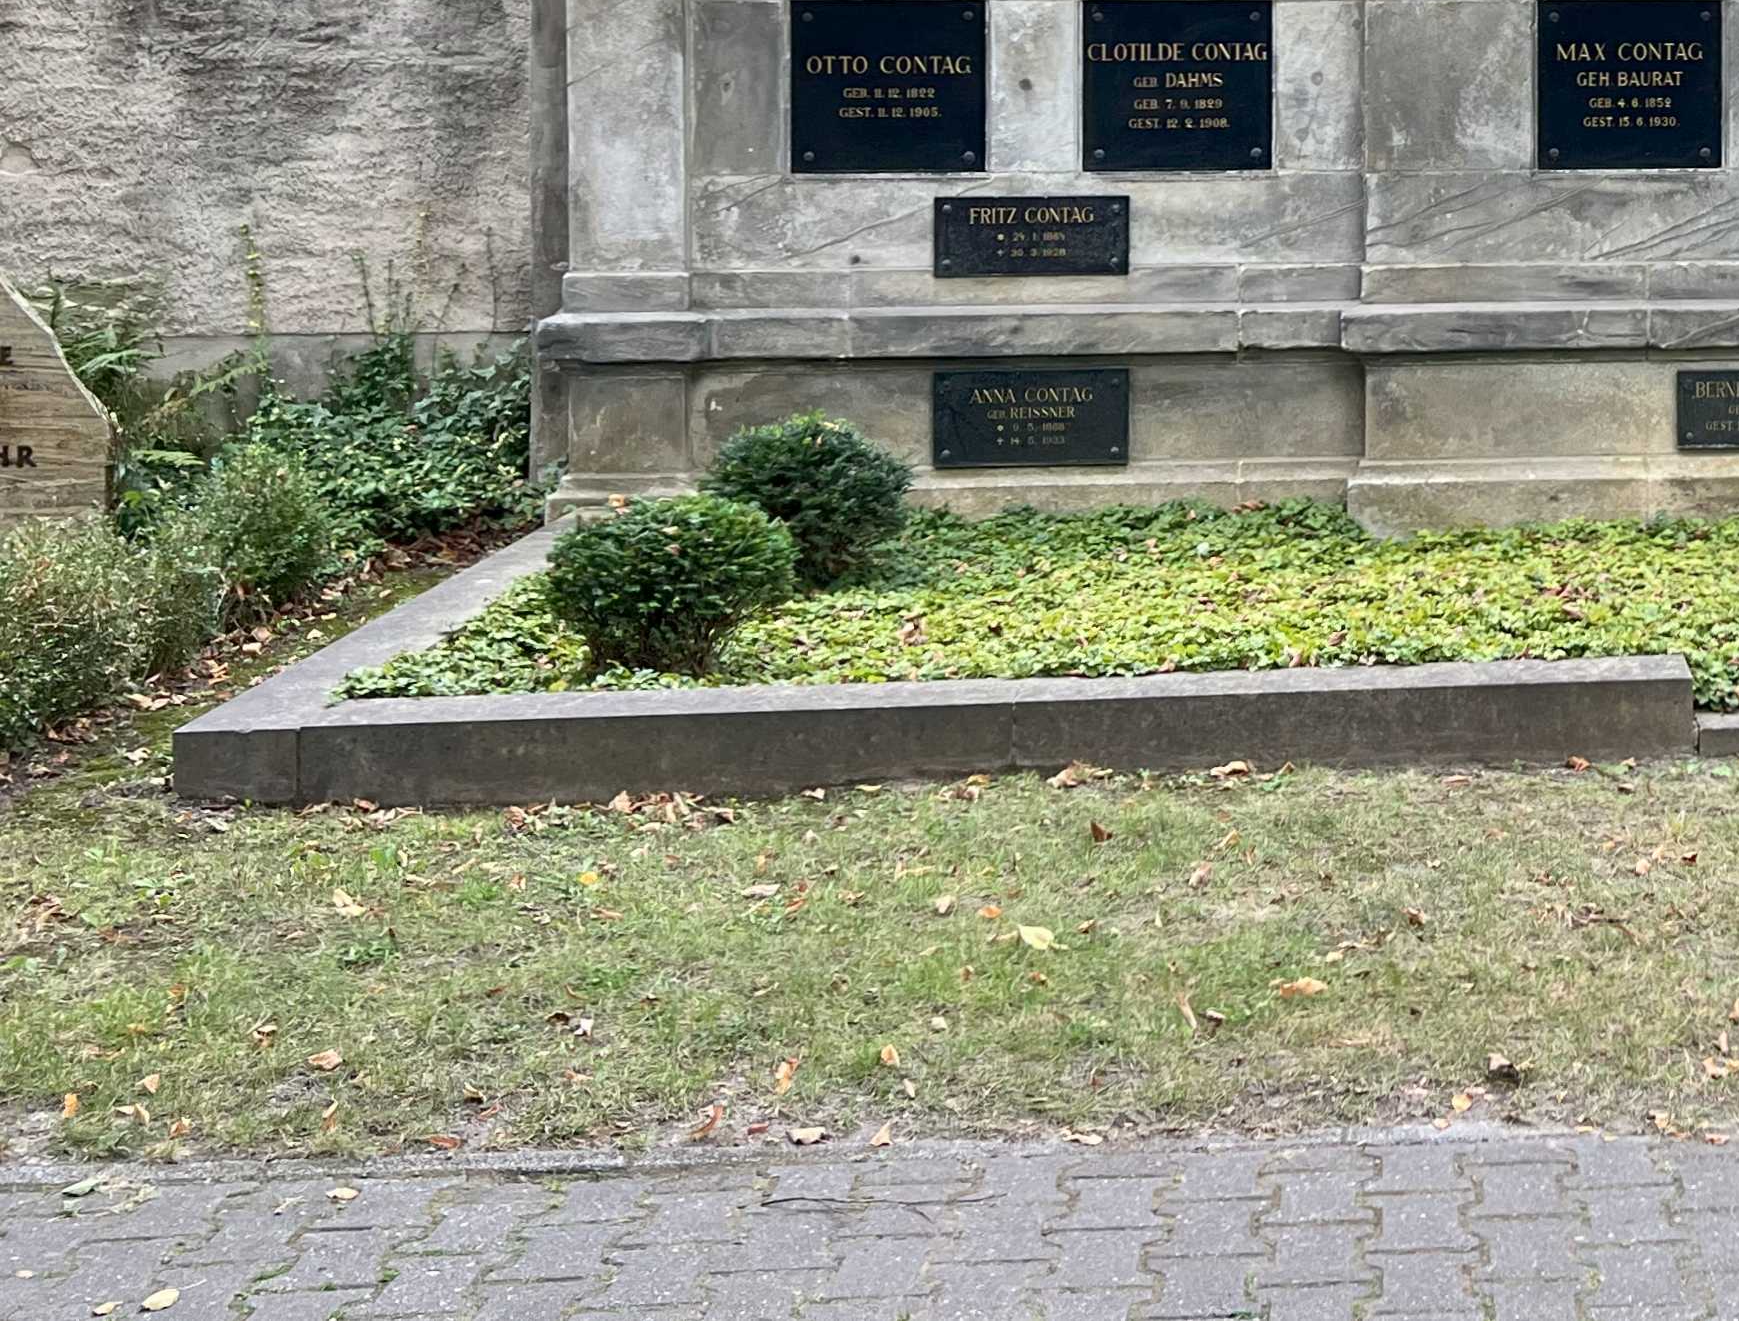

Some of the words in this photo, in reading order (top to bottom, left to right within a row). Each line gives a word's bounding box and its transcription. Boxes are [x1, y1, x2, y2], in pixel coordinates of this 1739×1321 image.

[1087, 42, 1185, 62] CLOTILDE
[1191, 42, 1267, 62] CONTAG
[1556, 42, 1607, 62] MAX
[1617, 42, 1704, 62] CONTAG
[806, 55, 868, 74] OTTO
[879, 55, 973, 74] CONTAG
[1165, 72, 1224, 88] DAHMS
[1617, 71, 1684, 87] BAURAT
[843, 87, 871, 99] GEB.
[906, 87, 935, 99] 1822
[1165, 99, 1176, 110] 7.
[1194, 99, 1223, 110] 1829
[1589, 97, 1616, 109] GEB.
[1617, 97, 1629, 109] 4.
[1644, 97, 1672, 109] 1852
[838, 107, 875, 118] GEST.
[969, 207, 1017, 225] FRITZ
[1024, 207, 1095, 225] CONTAG
[969, 387, 1017, 404] ANNA
[1024, 387, 1093, 404] CONTAG
[1009, 407, 1076, 420] REISSNER
